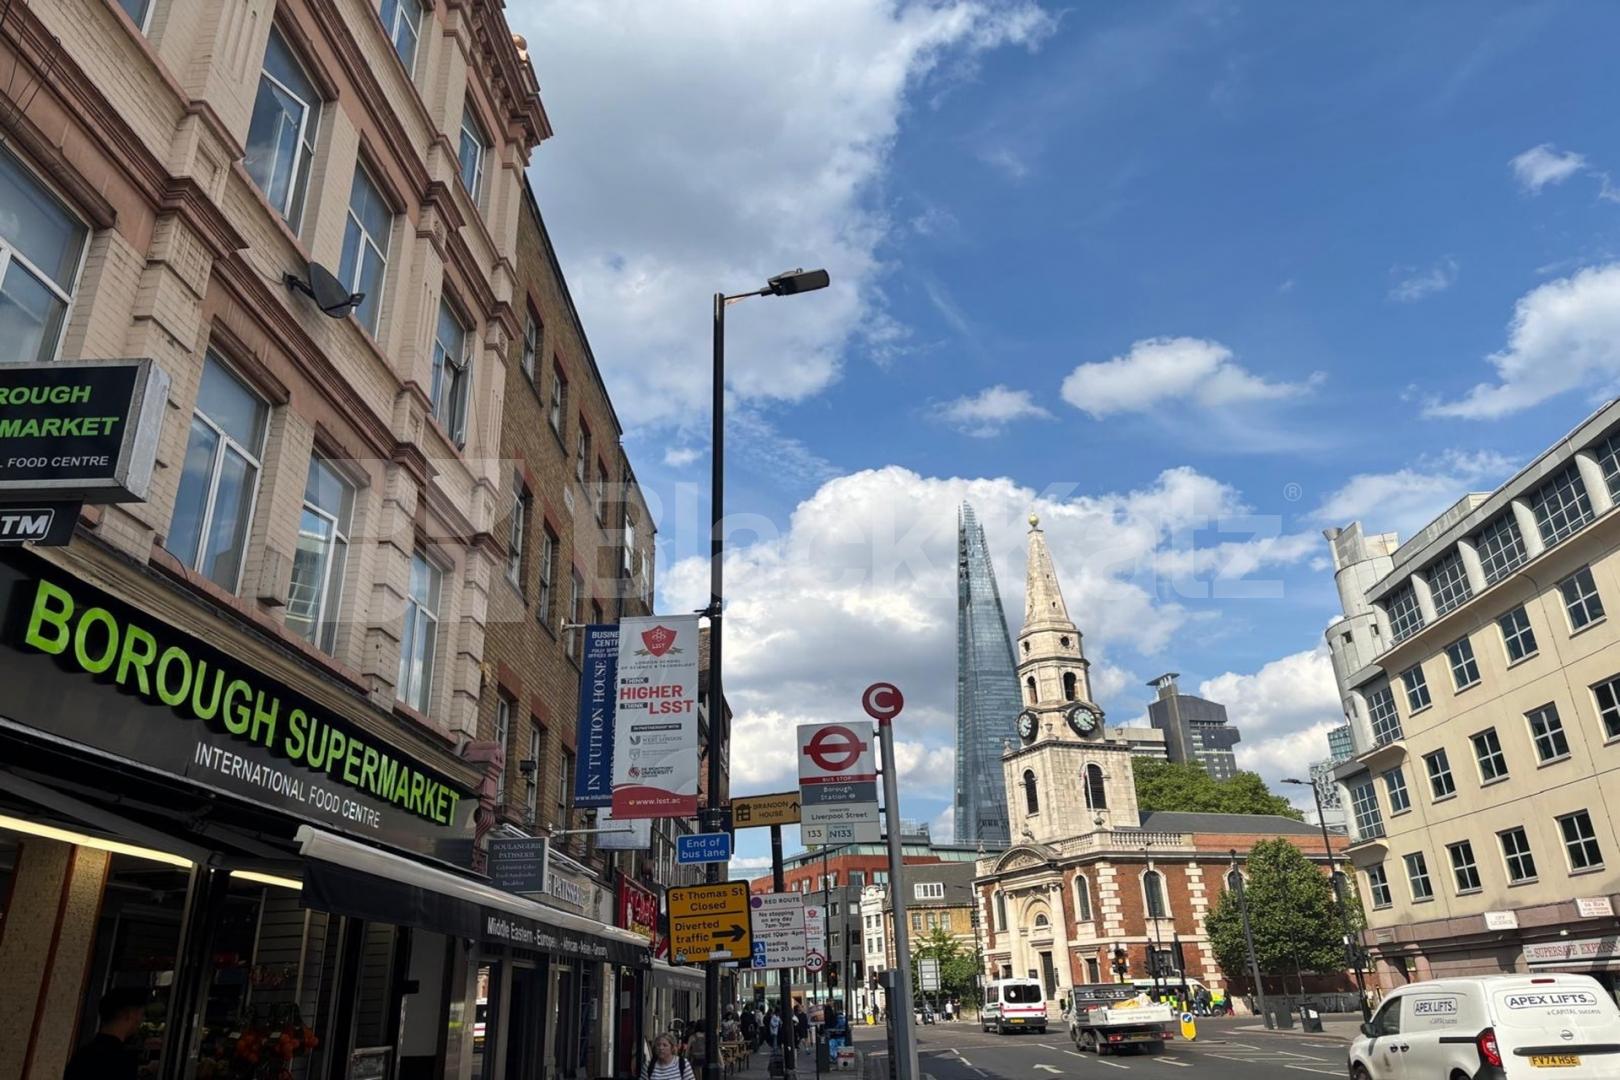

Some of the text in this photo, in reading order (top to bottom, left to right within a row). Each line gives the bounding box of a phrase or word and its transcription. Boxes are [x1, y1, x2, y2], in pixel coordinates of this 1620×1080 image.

[0, 417, 119, 438] MARKET
[7, 457, 48, 468] FOOD
[51, 456, 109, 468] CENTRE
[592, 660, 607, 703] HOUSE
[620, 685, 683, 700] HIGHER
[25, 579, 280, 749] BOROUGH
[285, 708, 460, 826] SUPERMARKET
[869, 686, 895, 713] C
[649, 700, 694, 714] LSST
[194, 741, 381, 829] INTERNATIONAL FOOD CENTRE
[823, 786, 853, 794] Borough
[752, 801, 789, 810] BRANDON
[759, 810, 784, 818] HOUSE
[811, 811, 867, 821] Liverpool Street
[807, 830, 852, 838] 133 N133
[686, 837, 720, 848] End of
[682, 848, 726, 859] bus lane
[671, 887, 744, 901] St Thomas St
[690, 900, 727, 911] Closed
[487, 916, 511, 939] Middle
[511, 921, 534, 944] Eastern
[674, 920, 720, 931] Diverted
[675, 932, 710, 944] traffic
[675, 945, 712, 956] Follow
[1534, 944, 1578, 959] SUPERSAVE
[1579, 940, 1618, 955] EXPRESS
[807, 957, 821, 967] 20
[1510, 993, 1587, 1006] APEX LIFTS
[1415, 1001, 1453, 1013] APEX LIFTS
[1532, 1055, 1578, 1066] FV74 HSE
